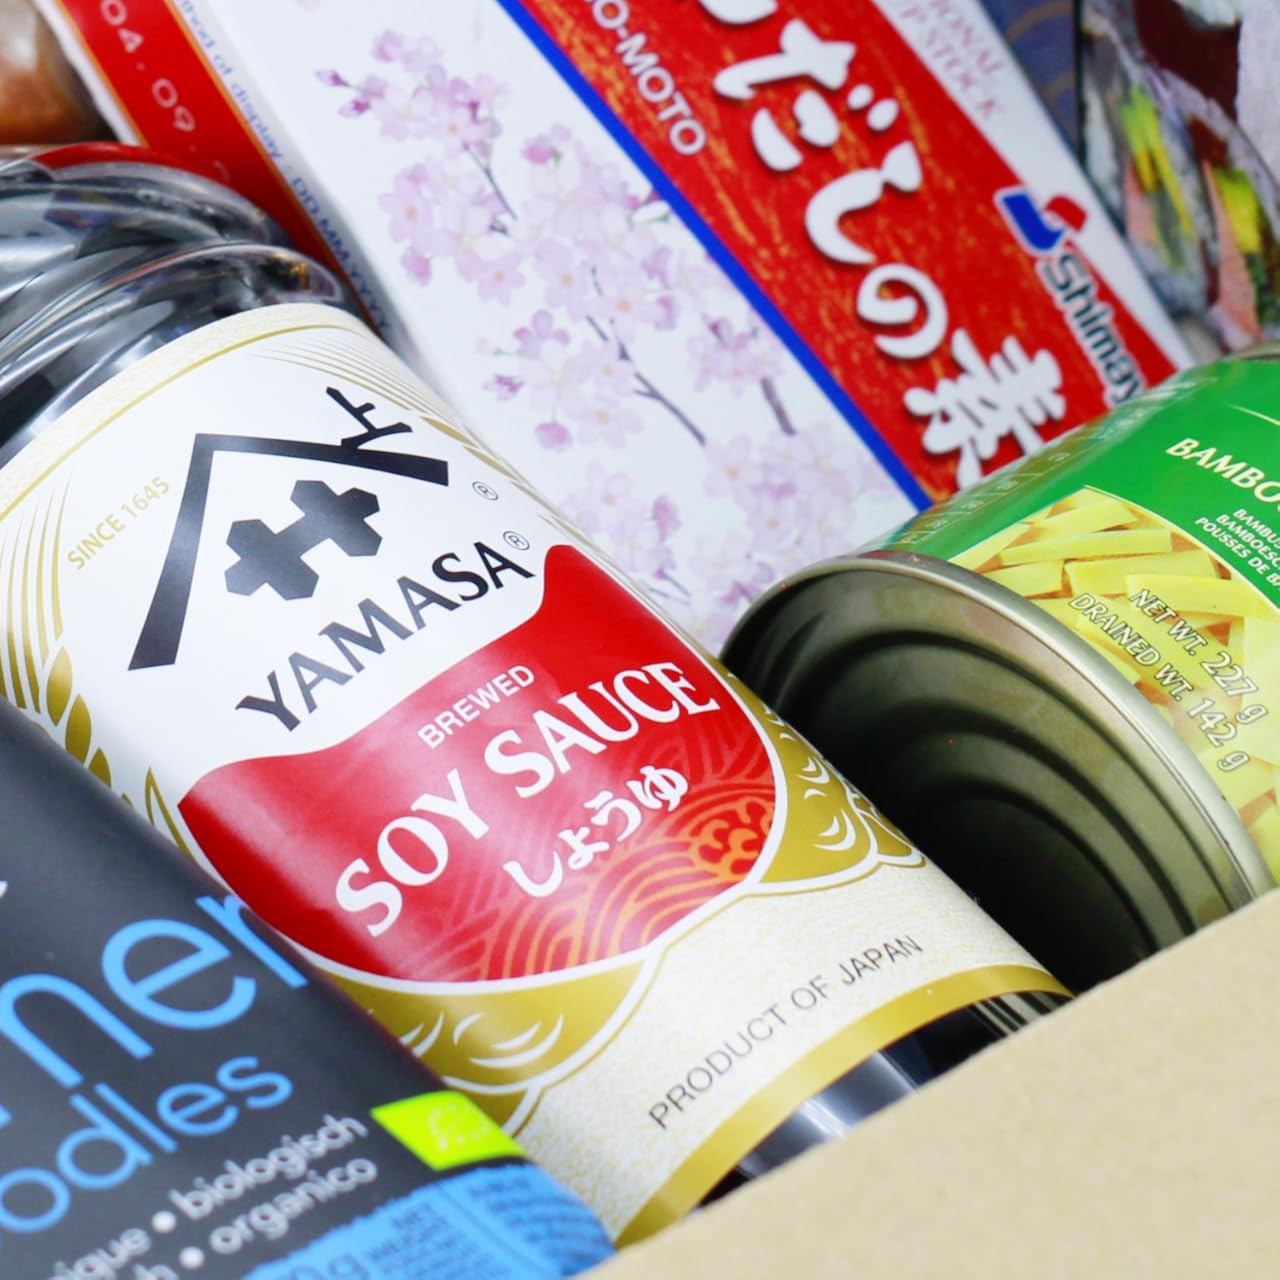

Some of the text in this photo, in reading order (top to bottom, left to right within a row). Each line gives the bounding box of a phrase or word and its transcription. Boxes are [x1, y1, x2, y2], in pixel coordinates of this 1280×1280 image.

[67, 476, 171, 570] SINCE 1645
[1166, 437, 1280, 512] BAMBO
[1194, 516, 1252, 560] POUSSES
[1247, 556, 1271, 576] DE
[235, 542, 537, 733] YAMASA
[1068, 593, 1250, 772] DRAINED WT. 142 g
[1129, 588, 1269, 725] NET WT. 227 g
[417, 664, 536, 750] BREWED
[334, 661, 721, 938] SOY SAUCE
[503, 765, 690, 899] しょうゆ
[649, 934, 923, 1131] PRODUCT OF JAPAN
[168, 1112, 368, 1221] biologisch
[208, 1157, 378, 1255] organico
